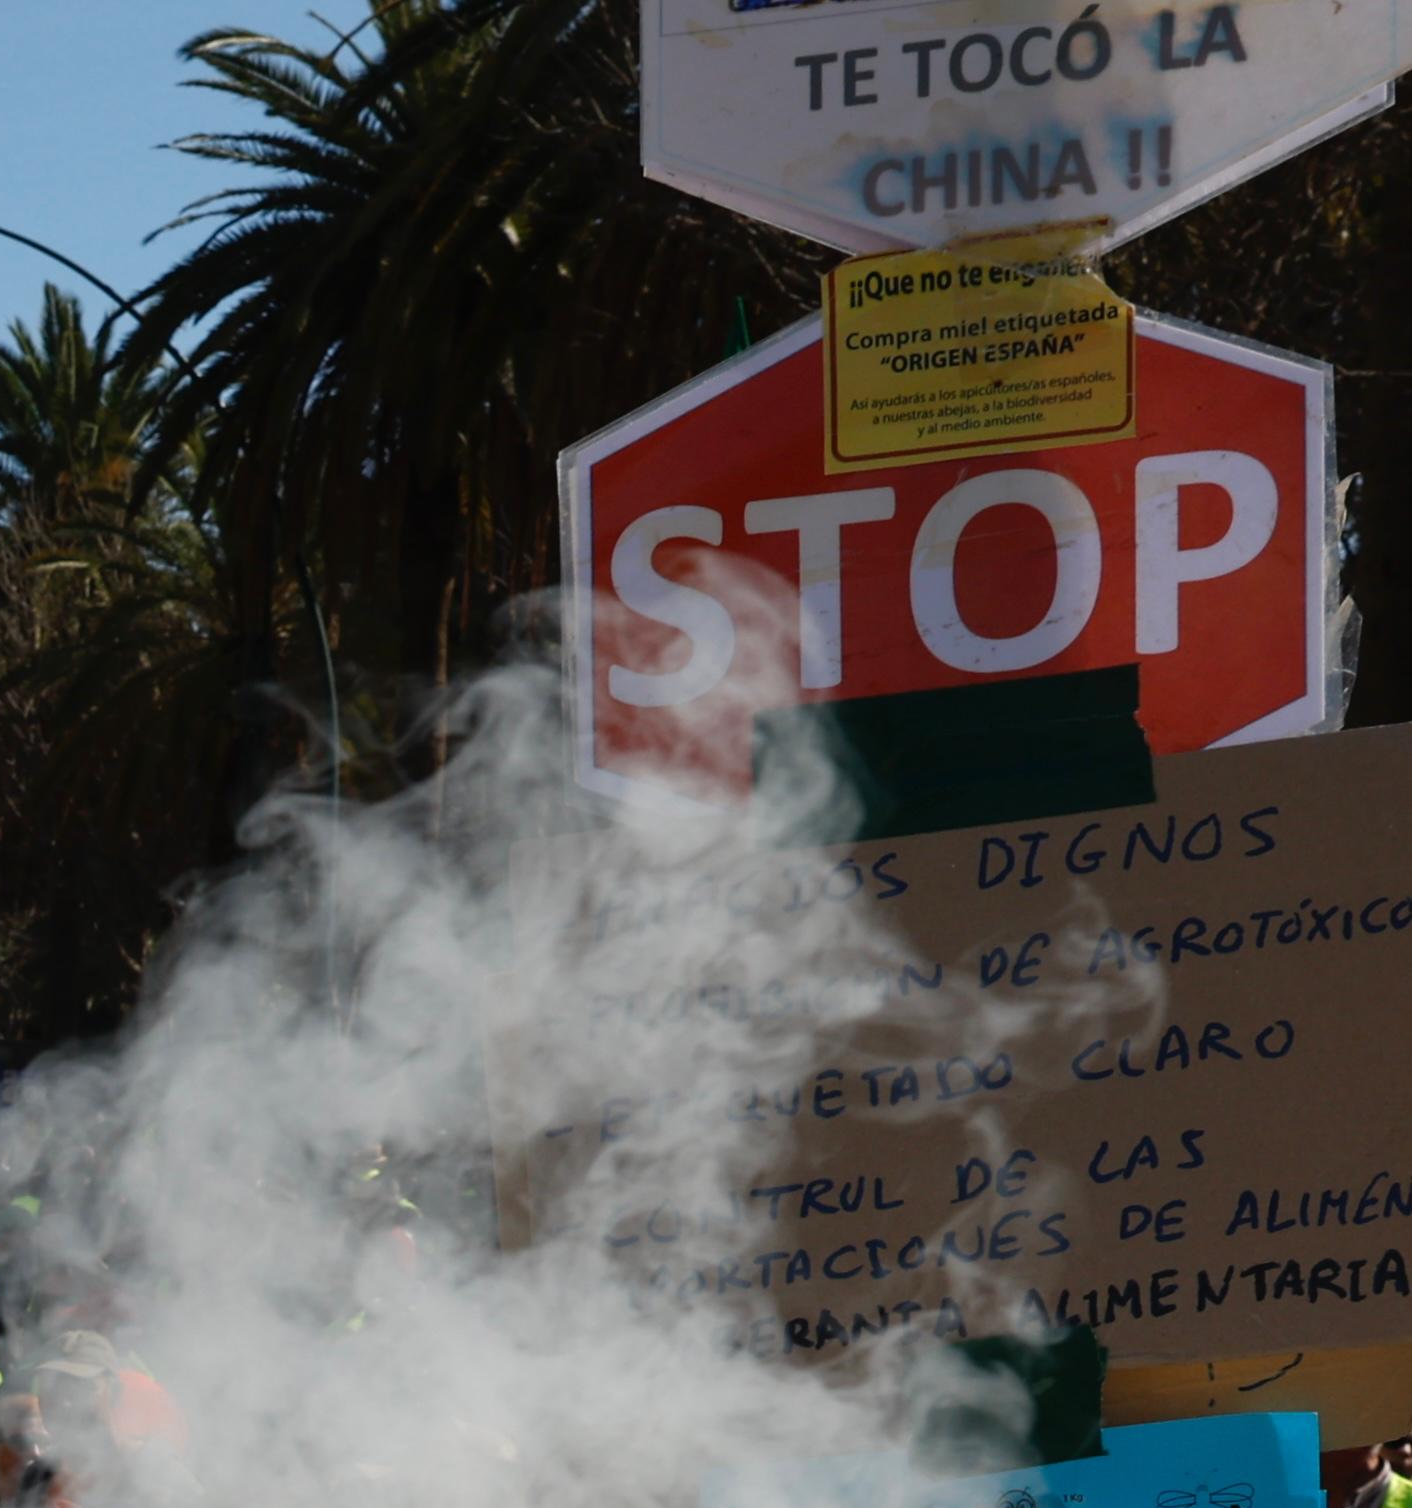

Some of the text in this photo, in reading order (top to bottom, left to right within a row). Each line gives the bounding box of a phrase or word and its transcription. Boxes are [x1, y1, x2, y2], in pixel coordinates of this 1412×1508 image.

[795, 3, 1248, 111] TE TOCÓ LA
[862, 124, 1173, 218] CHINA !!
[921, 268, 952, 293] no
[959, 264, 982, 286] te
[845, 302, 1119, 351] Compra miel etiquetada
[850, 397, 869, 411] Así
[871, 391, 927, 411] ayudarás
[928, 393, 936, 402] a
[939, 388, 958, 400] los
[1048, 369, 1116, 393] españoles,
[872, 417, 880, 426] a
[882, 410, 934, 424] nuestras
[983, 403, 990, 412] a
[992, 399, 1004, 411] la
[1006, 388, 1092, 409] biodiversidad
[917, 426, 925, 439] y
[927, 422, 938, 435] al
[940, 416, 980, 432] medio
[608, 449, 1279, 709] STOP
[978, 806, 1280, 890] DIGNOS
[979, 932, 1051, 990] DE
[1071, 1019, 1295, 1081] CLARO
[951, 1148, 1037, 1204] DE
[1088, 1128, 1206, 1184] LAS
[1119, 1199, 1187, 1243] DE
[1016, 1248, 1411, 1334] ALIMENTARIA
